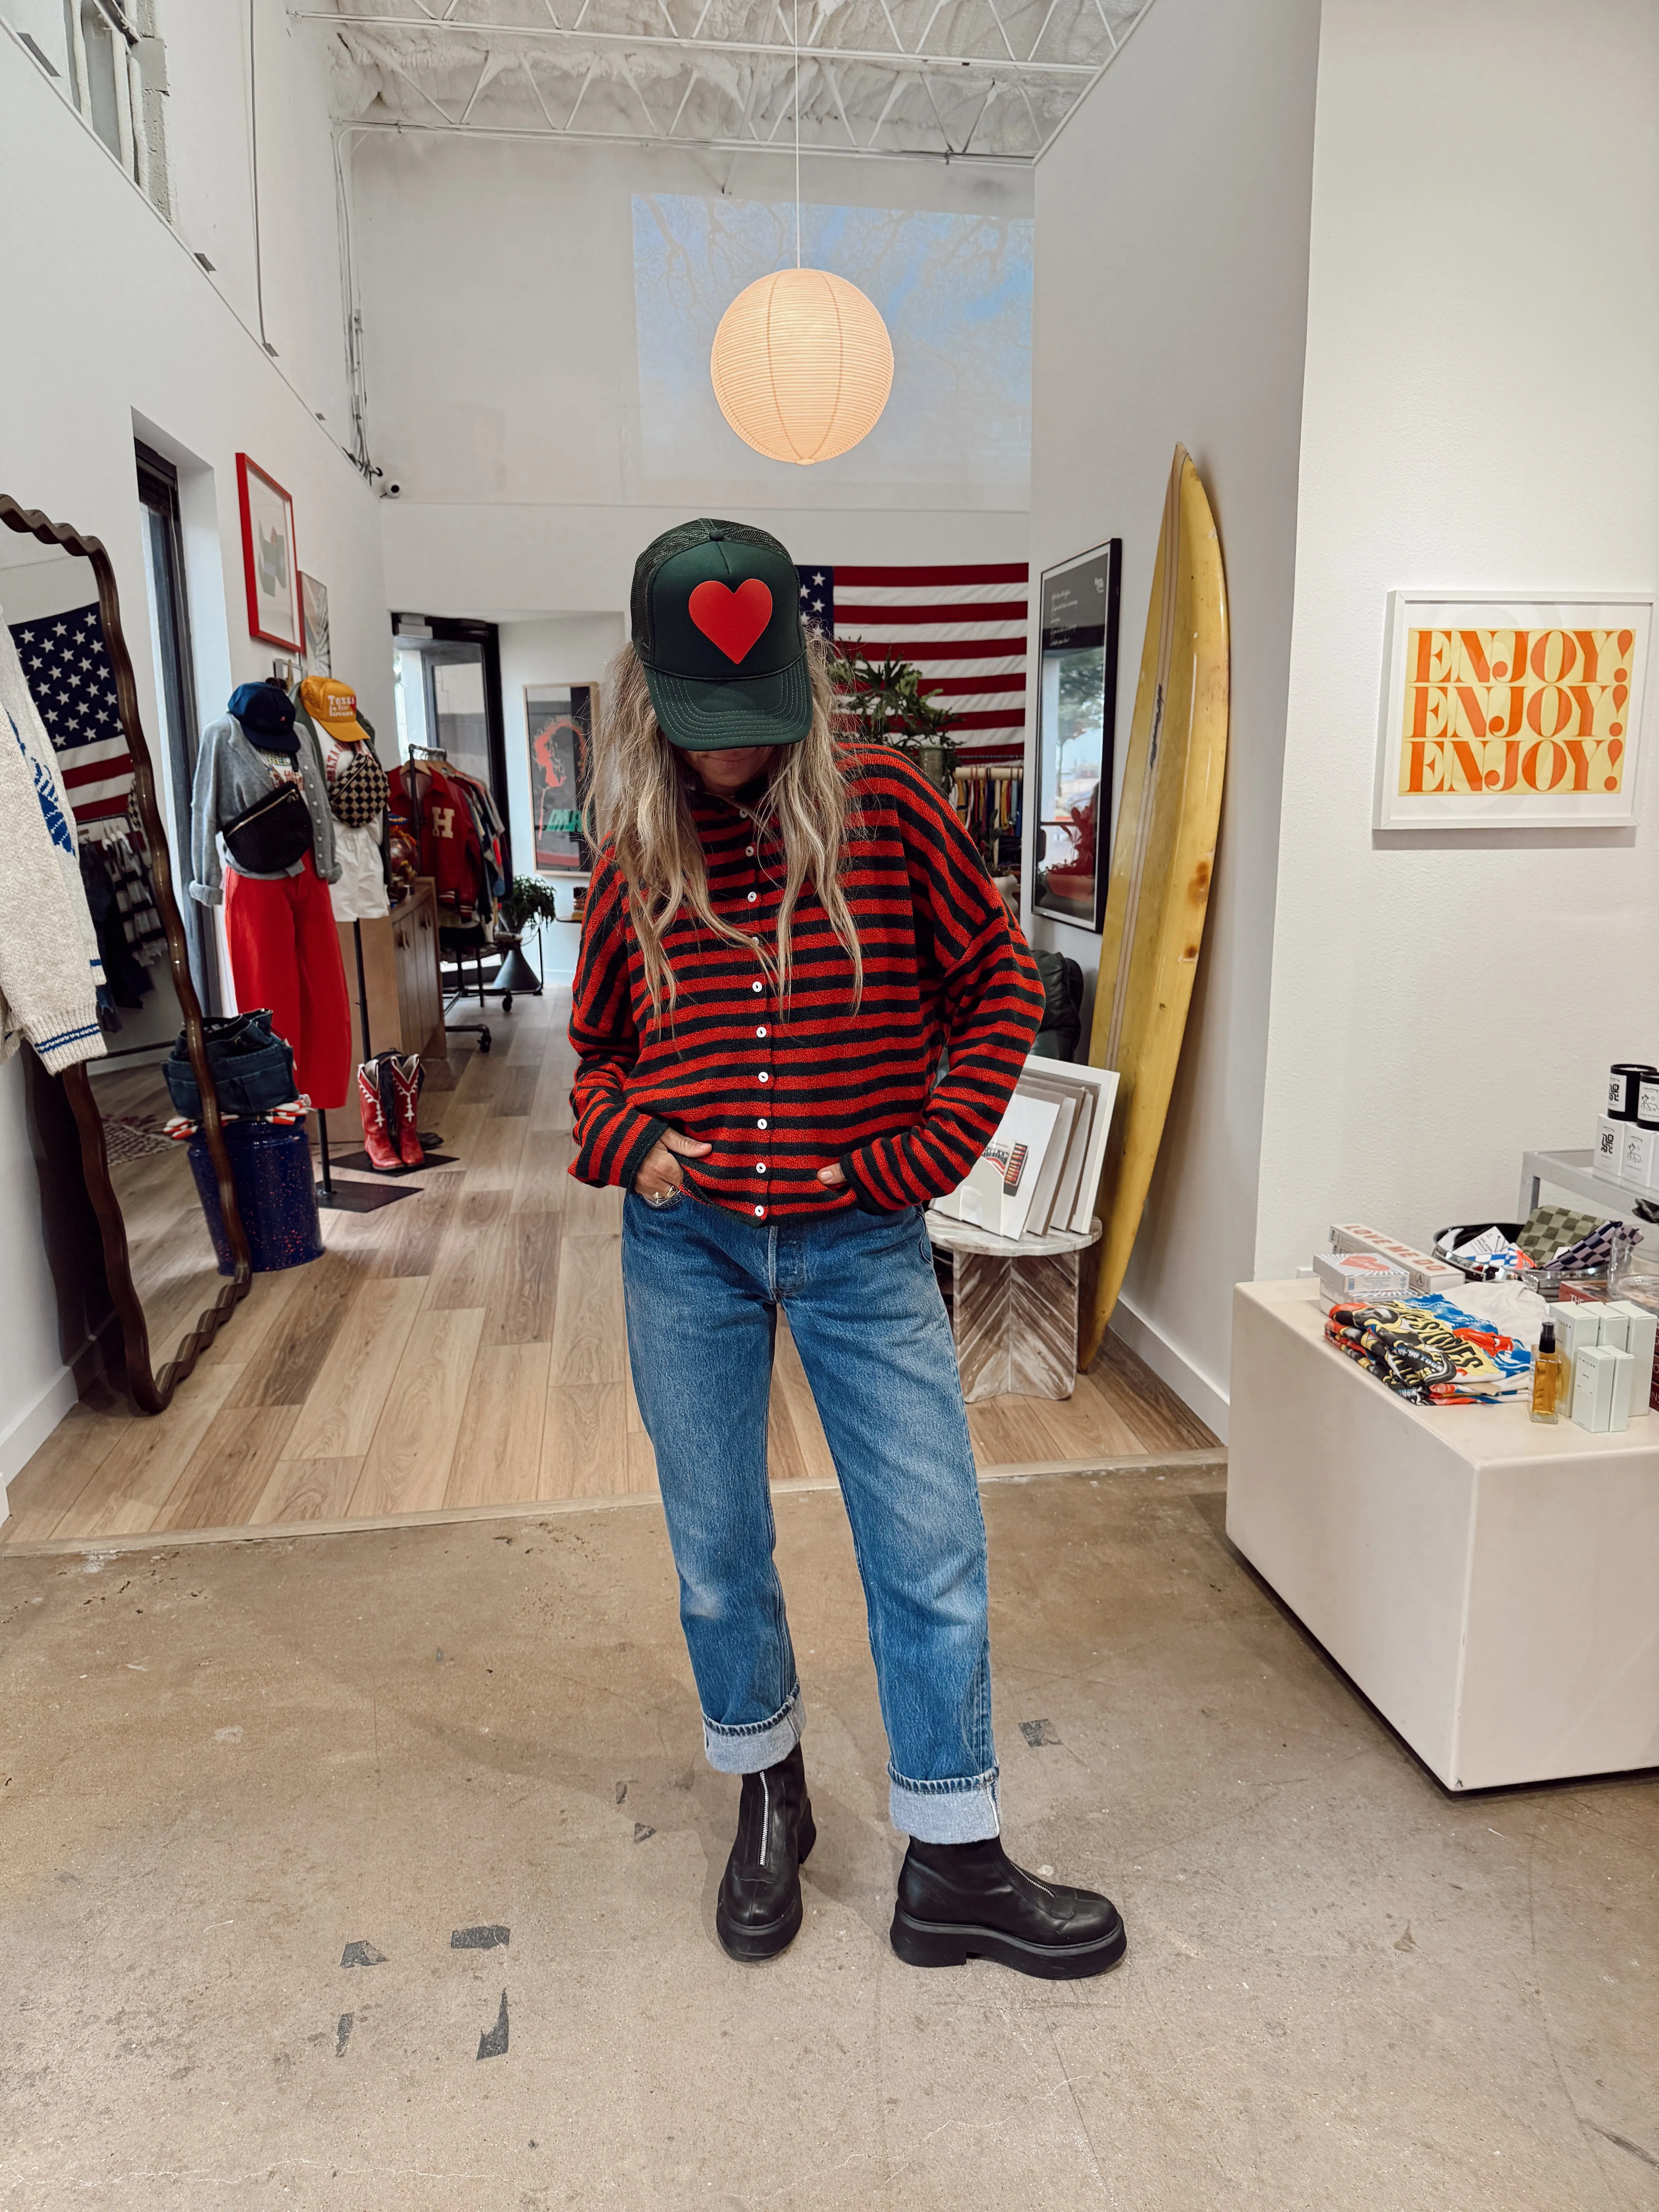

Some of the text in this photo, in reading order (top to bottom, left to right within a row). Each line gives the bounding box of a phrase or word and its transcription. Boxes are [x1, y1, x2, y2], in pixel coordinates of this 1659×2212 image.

[1413, 629, 1633, 684] ENJOY!
[1405, 684, 1628, 738] ENJOY!
[1400, 738, 1623, 793] ENJOY!
[432, 806, 455, 839] H
[1343, 1225, 1446, 1271] LOVE ME DO
